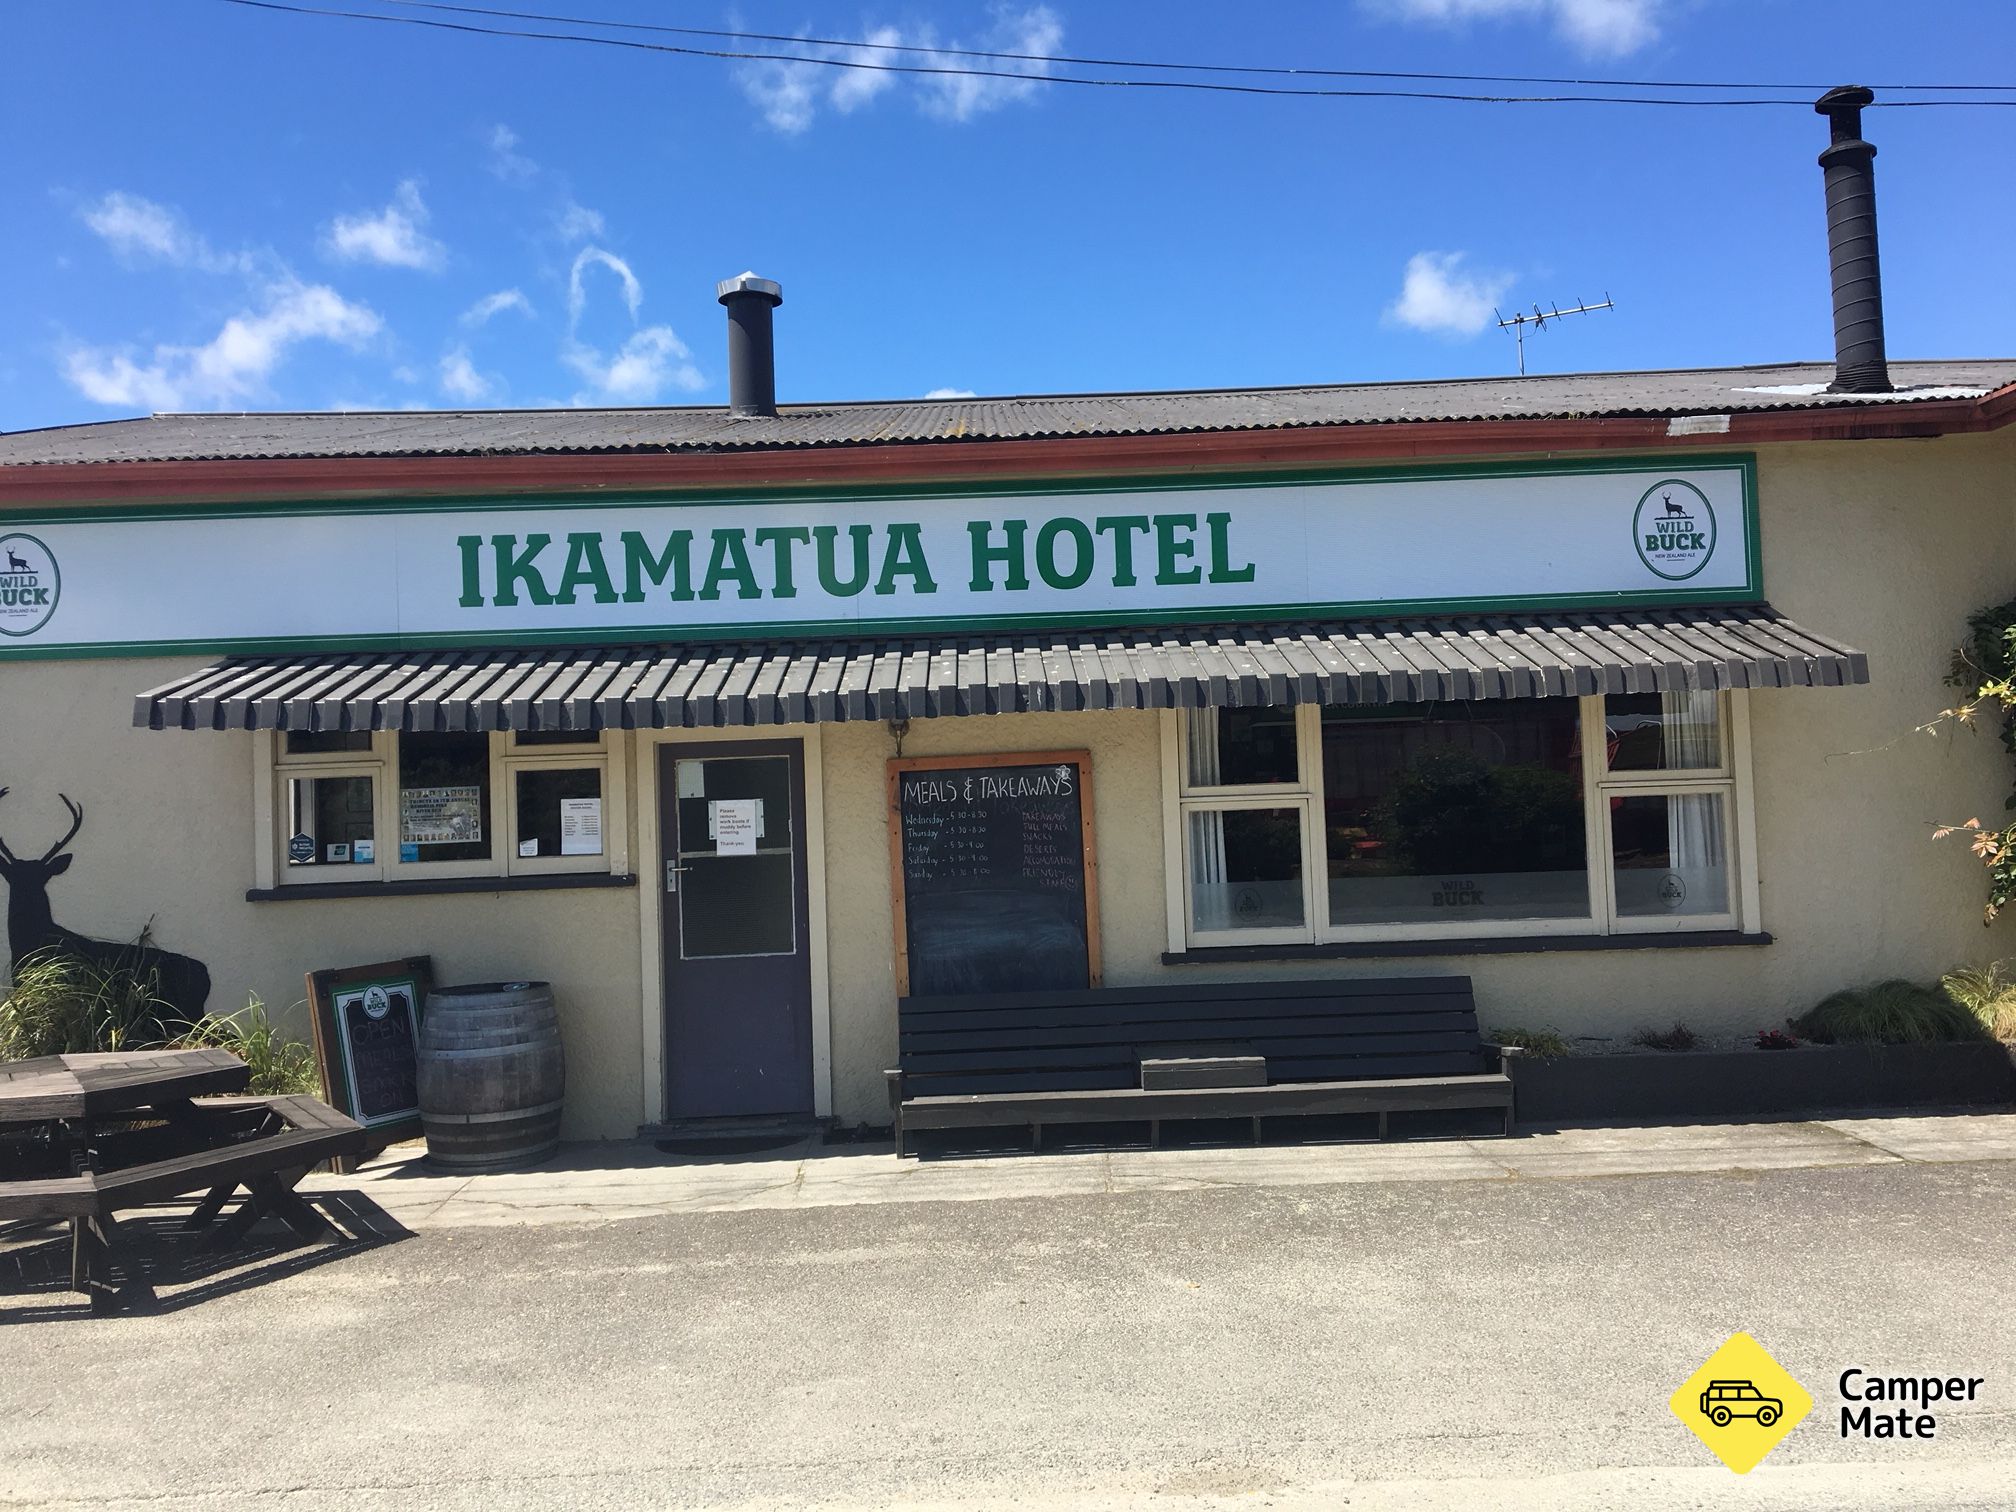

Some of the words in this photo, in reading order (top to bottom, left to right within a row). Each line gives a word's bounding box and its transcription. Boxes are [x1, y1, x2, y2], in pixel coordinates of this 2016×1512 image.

[1656, 521, 1694, 533] WILD
[1645, 533, 1706, 551] BUCK
[456, 522, 937, 608] IKAMATUA
[968, 511, 1256, 592] HOTEL
[0, 576, 38, 588] WILD
[0, 588, 49, 606] UCK
[904, 780, 957, 804] MEALS
[963, 777, 973, 804] &
[979, 775, 1073, 798] TAKEAWAYS
[905, 812, 944, 827] Wednesday
[907, 828, 938, 840] Thursday
[1022, 832, 1052, 841] SNACKS
[907, 843, 929, 855] Friday
[908, 855, 938, 866] Saturday
[1441, 881, 1474, 890] WILD
[1432, 891, 1484, 906] BUCK
[367, 1001, 386, 1010] BUCK
[352, 1018, 405, 1045] OPEN
